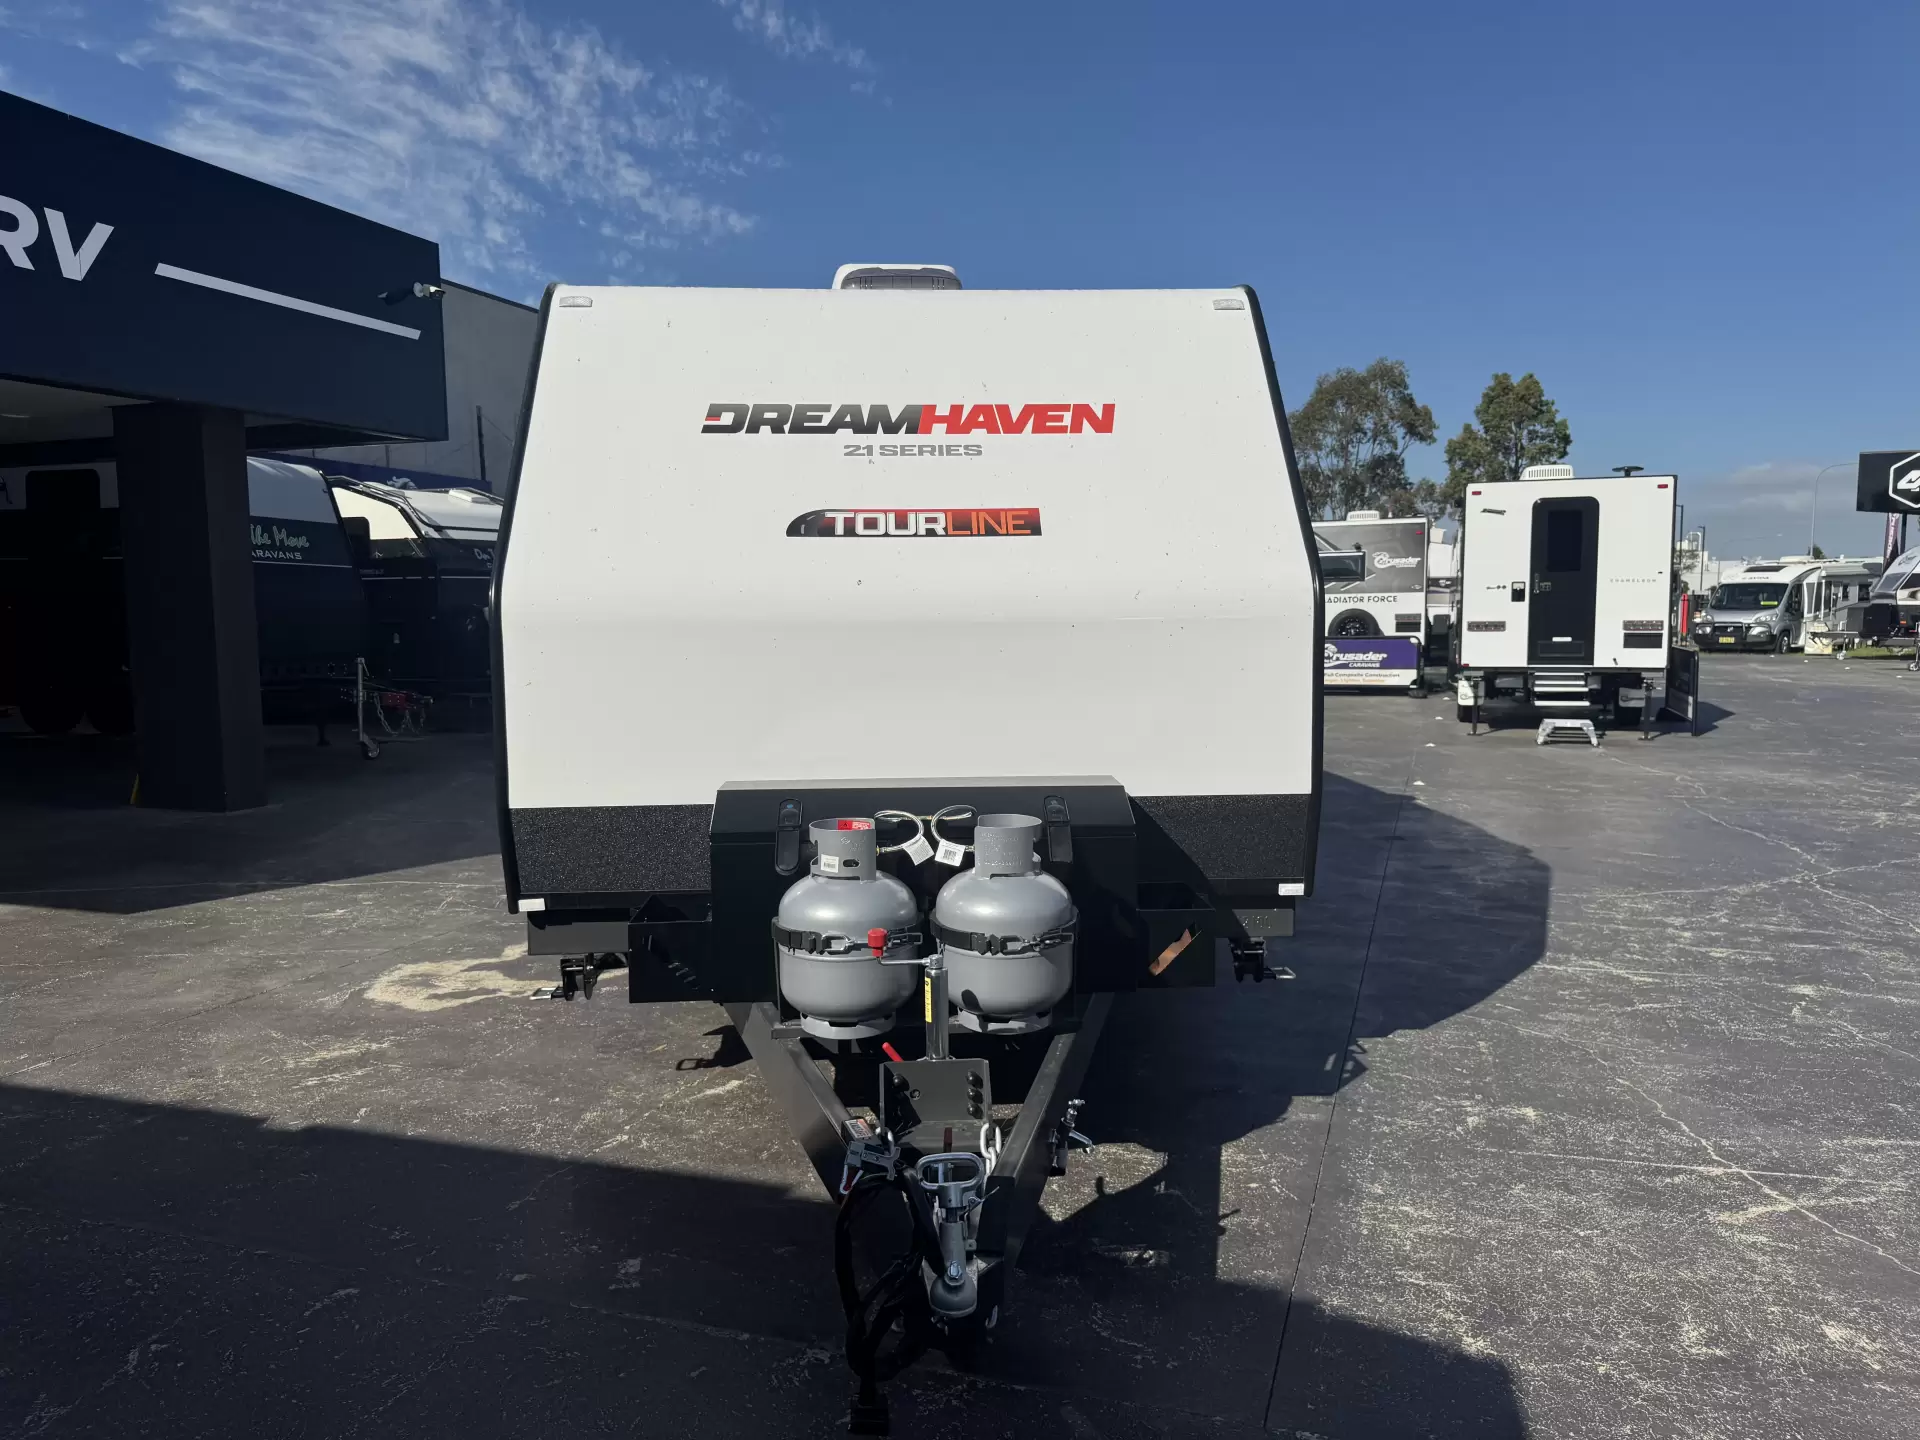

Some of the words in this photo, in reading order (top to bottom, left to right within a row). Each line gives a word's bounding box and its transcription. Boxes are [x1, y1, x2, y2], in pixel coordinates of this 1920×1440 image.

[700, 403, 1116, 435] DREAMHAVEN
[843, 444, 875, 457] 21
[879, 444, 983, 457] SERIES
[824, 510, 1031, 536] TOURLINE
[273, 525, 310, 548] Move
[1325, 595, 1364, 603] ADIATOR
[1367, 595, 1398, 603] FORCE
